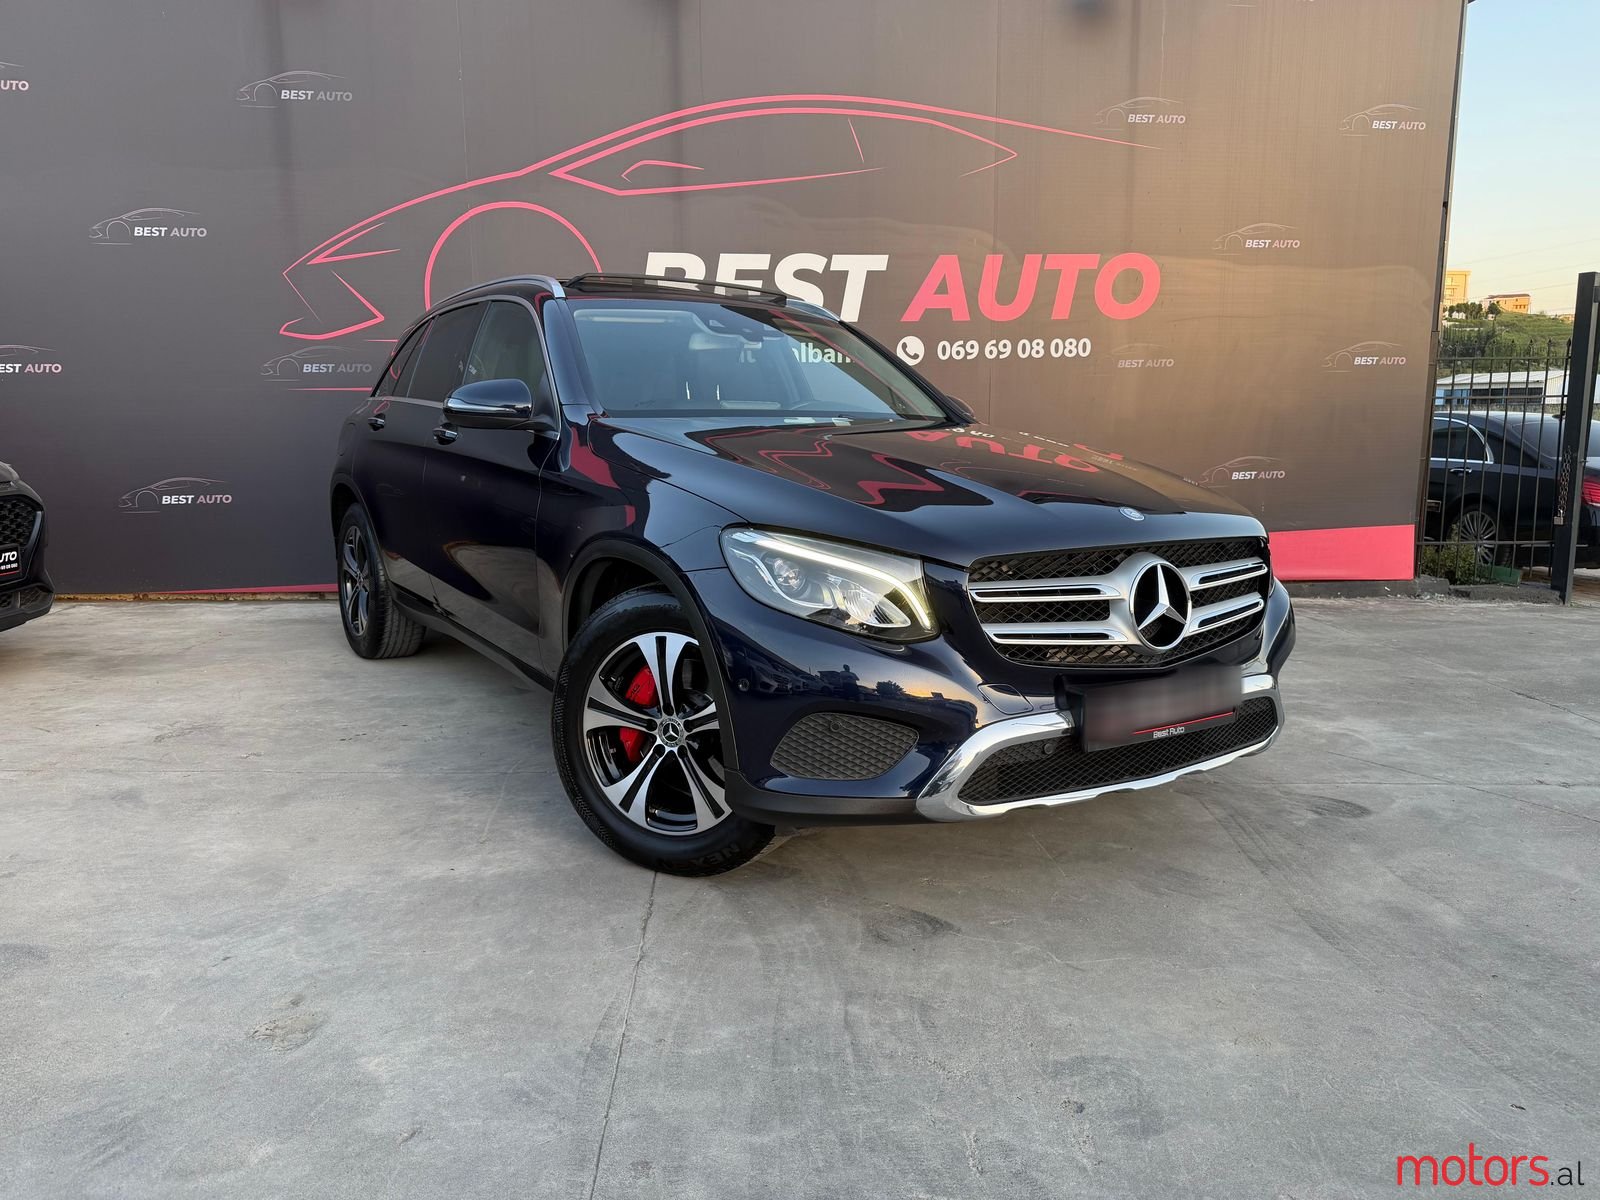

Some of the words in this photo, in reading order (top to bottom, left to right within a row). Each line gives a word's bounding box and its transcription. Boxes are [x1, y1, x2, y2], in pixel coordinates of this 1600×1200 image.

[0, 79, 30, 91] UTO
[280, 89, 314, 101] BEST
[316, 90, 353, 102] AUTO
[1127, 114, 1155, 124] BEST
[1156, 114, 1186, 125] AUTO
[1371, 120, 1397, 130] BEST
[1398, 121, 1426, 131] AUTO
[133, 226, 168, 237] BEST
[170, 227, 208, 238] AUTO
[1245, 239, 1271, 249] BEST
[1272, 239, 1300, 249] AUTO
[901, 252, 1162, 322] AUTO
[937, 339, 979, 361] 069
[985, 340, 1012, 360] 69
[1017, 339, 1045, 360] 08
[1050, 337, 1092, 359] 080
[1117, 360, 1144, 369] BEST
[1145, 359, 1175, 368] AUTO
[1354, 356, 1379, 366] BEST
[1380, 356, 1407, 366] AUTO
[0, 363, 22, 373] EST
[24, 363, 62, 373] AUTO
[303, 363, 335, 373] BEST
[337, 363, 373, 374] AUTO
[1231, 471, 1257, 480] BEST
[1258, 470, 1286, 480] AUTO
[162, 494, 195, 505] BEST
[197, 494, 232, 505] AUTO
[0, 551, 17, 563] UTO
[1153, 729, 1169, 739] Best
[1170, 726, 1185, 735] Auto
